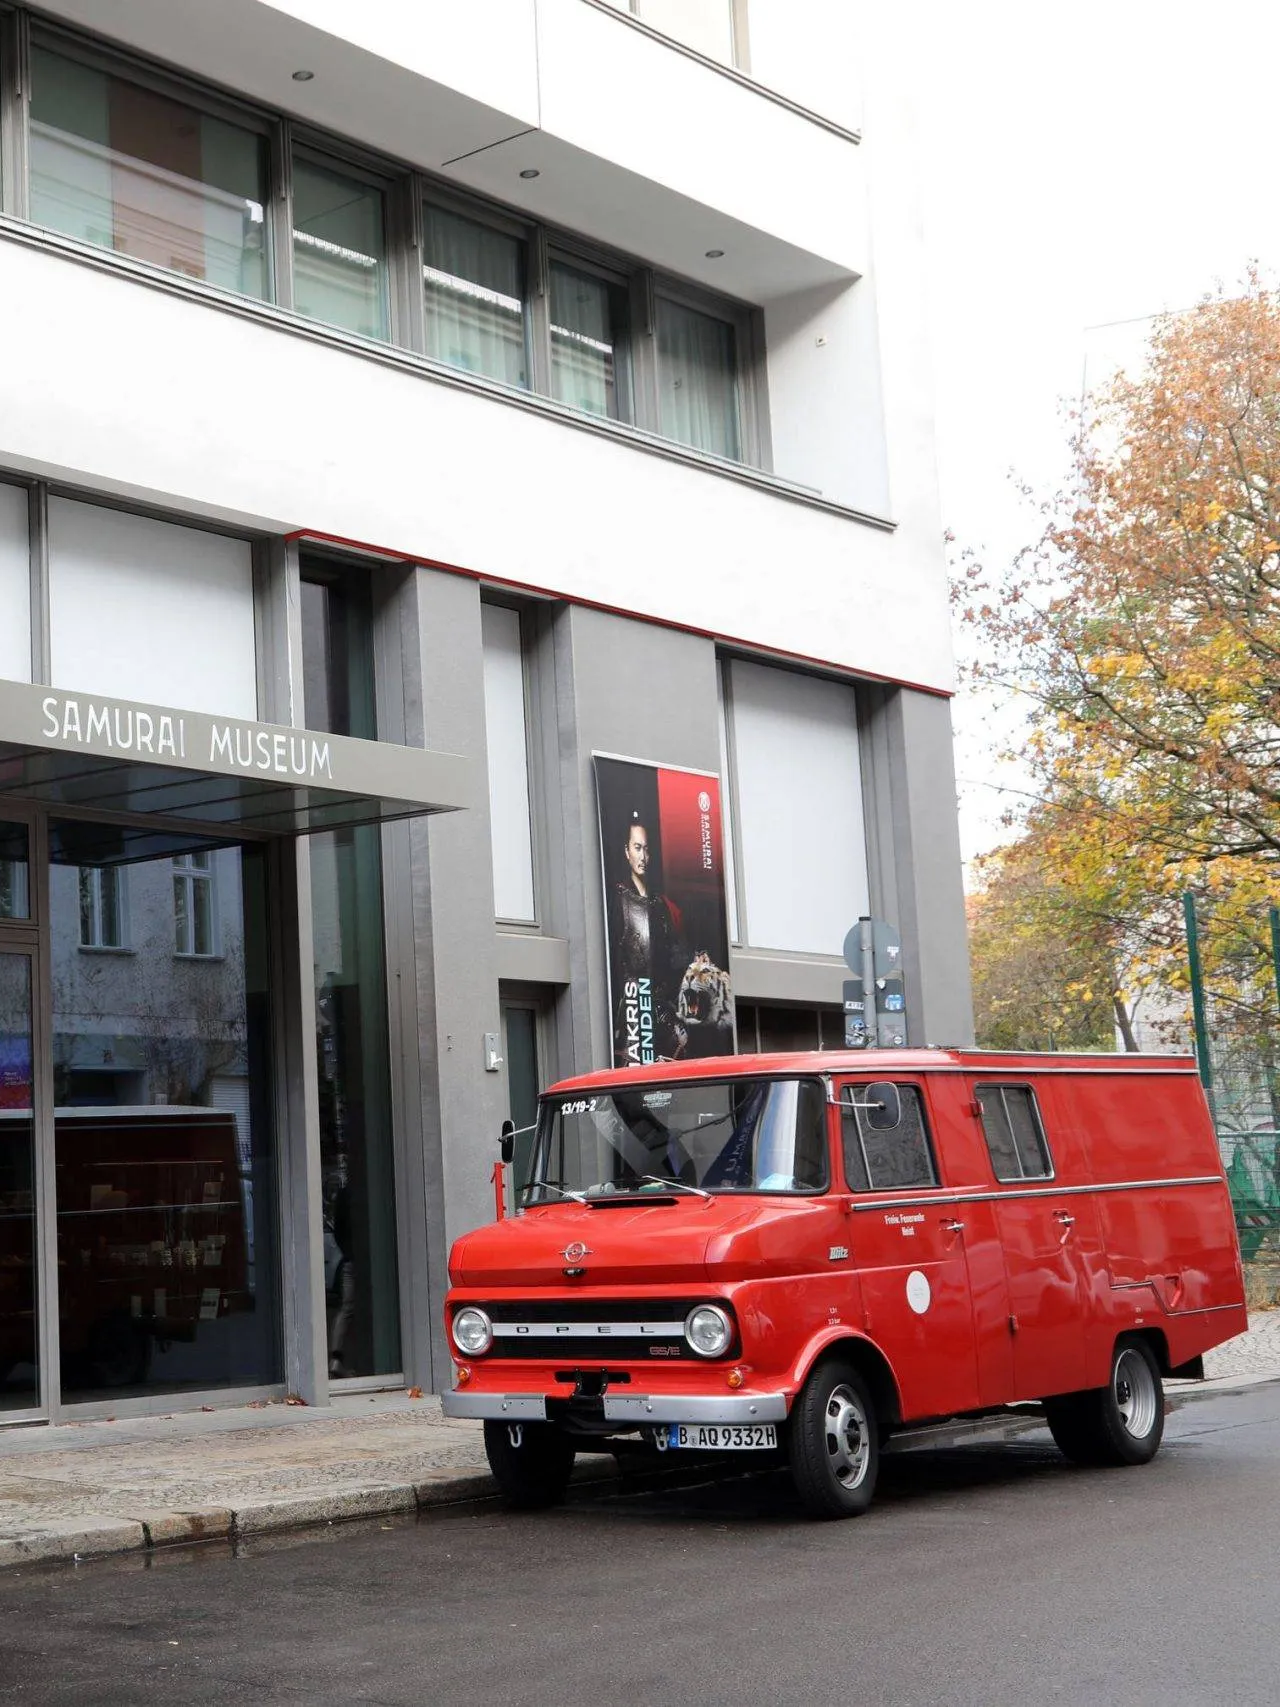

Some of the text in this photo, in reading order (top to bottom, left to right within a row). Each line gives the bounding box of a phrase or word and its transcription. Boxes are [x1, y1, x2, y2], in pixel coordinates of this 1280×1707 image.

[42, 697, 333, 779] SAMURAI MUSEUM
[561, 1098, 597, 1115] 13/19-2
[516, 1326, 645, 1334] OPEL
[679, 1426, 688, 1445] B
